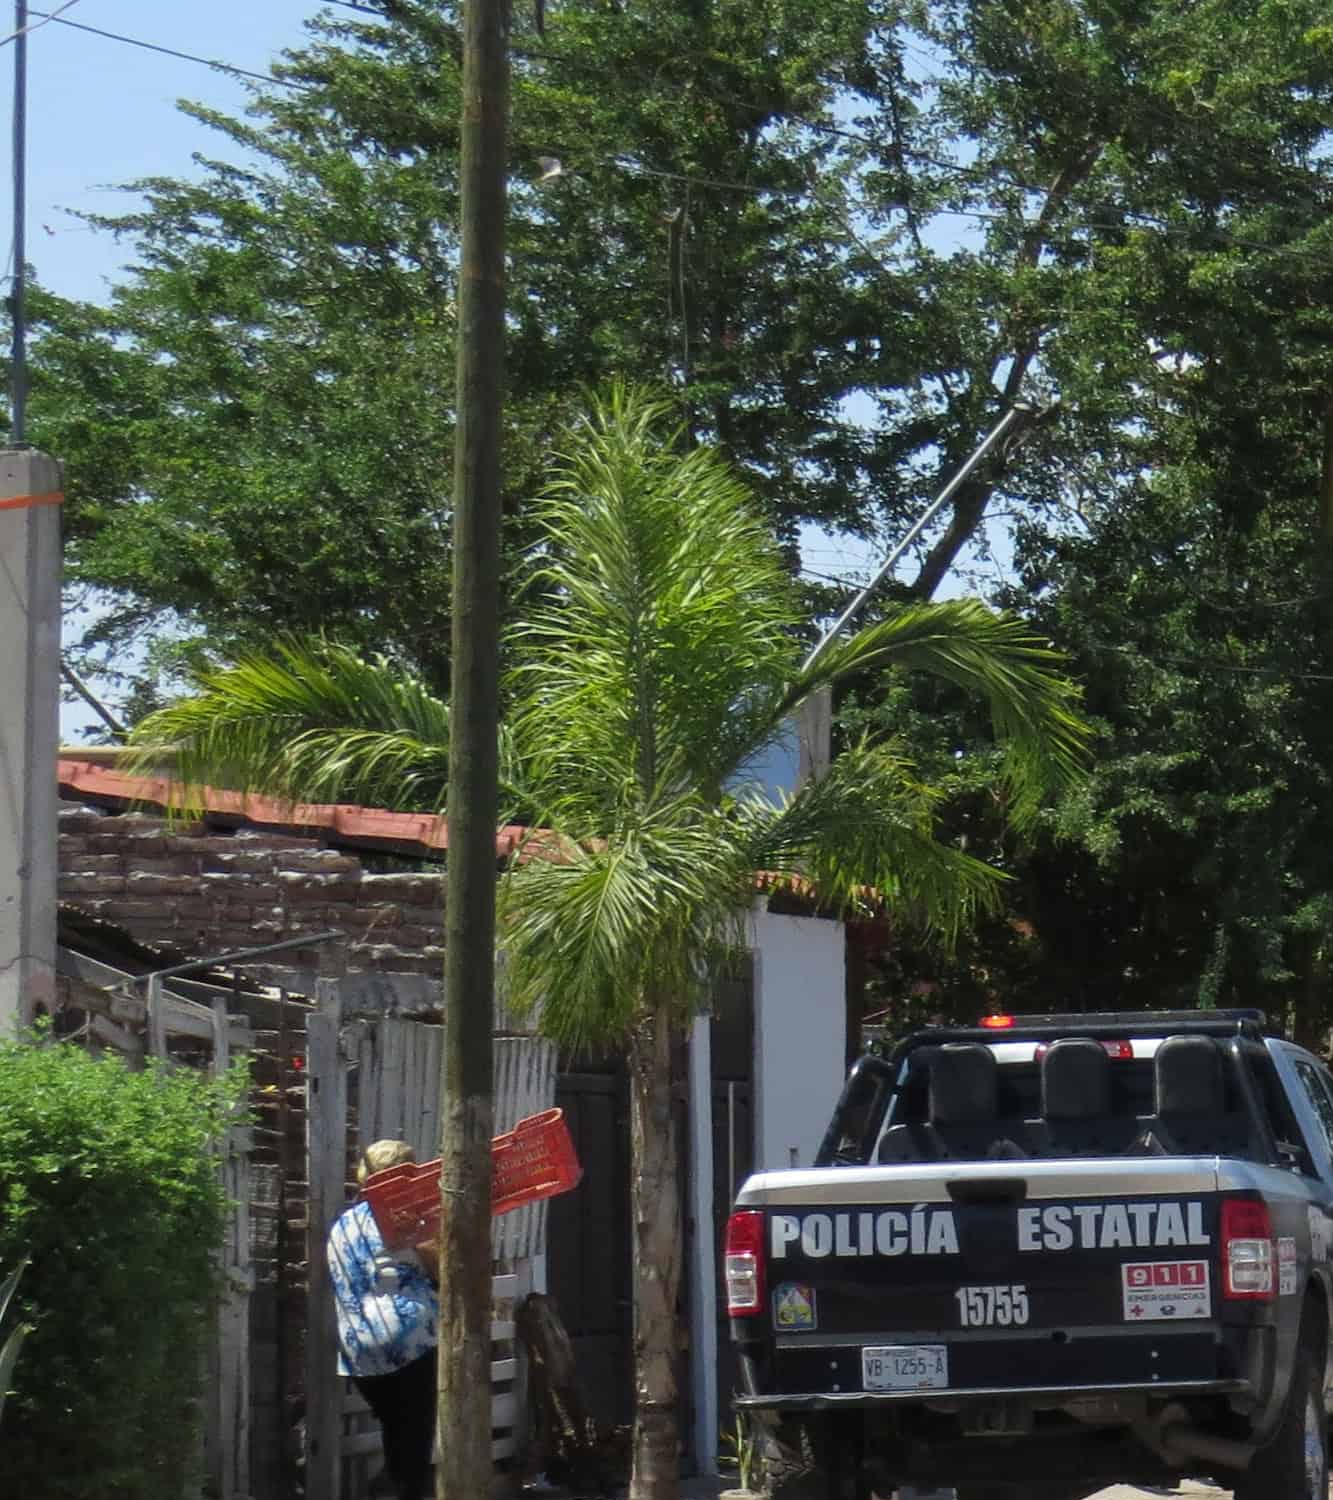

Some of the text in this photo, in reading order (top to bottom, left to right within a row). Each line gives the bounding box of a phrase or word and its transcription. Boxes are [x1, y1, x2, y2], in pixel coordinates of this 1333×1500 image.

[770, 1202, 1211, 1259] POLICÍA ESTATAL
[1132, 1265, 1198, 1284] 911
[955, 1285, 1029, 1326] 15755
